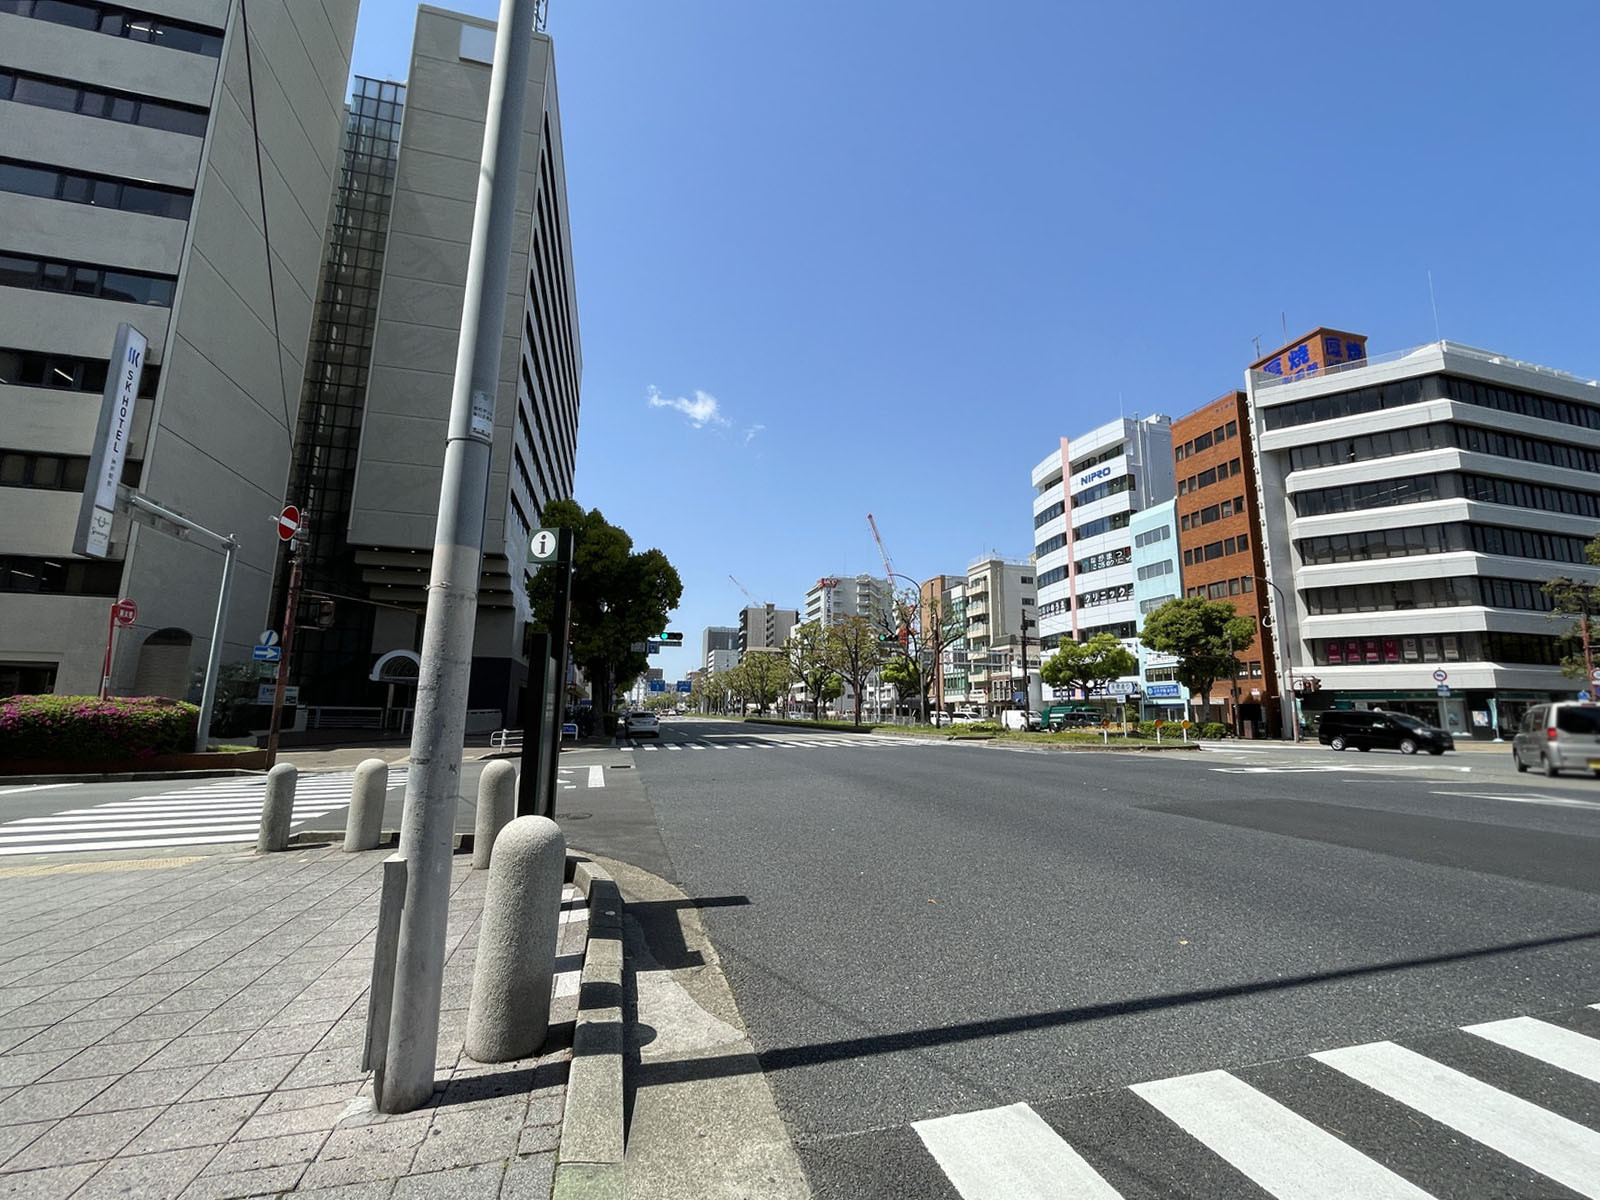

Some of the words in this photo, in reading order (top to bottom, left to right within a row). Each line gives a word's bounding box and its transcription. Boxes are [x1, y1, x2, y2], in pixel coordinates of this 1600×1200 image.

[125, 370, 134, 393] SK
[113, 396, 130, 454] HOTEL
[1080, 466, 1111, 486] NIPRO
[1085, 587, 1126, 603] クリニック
